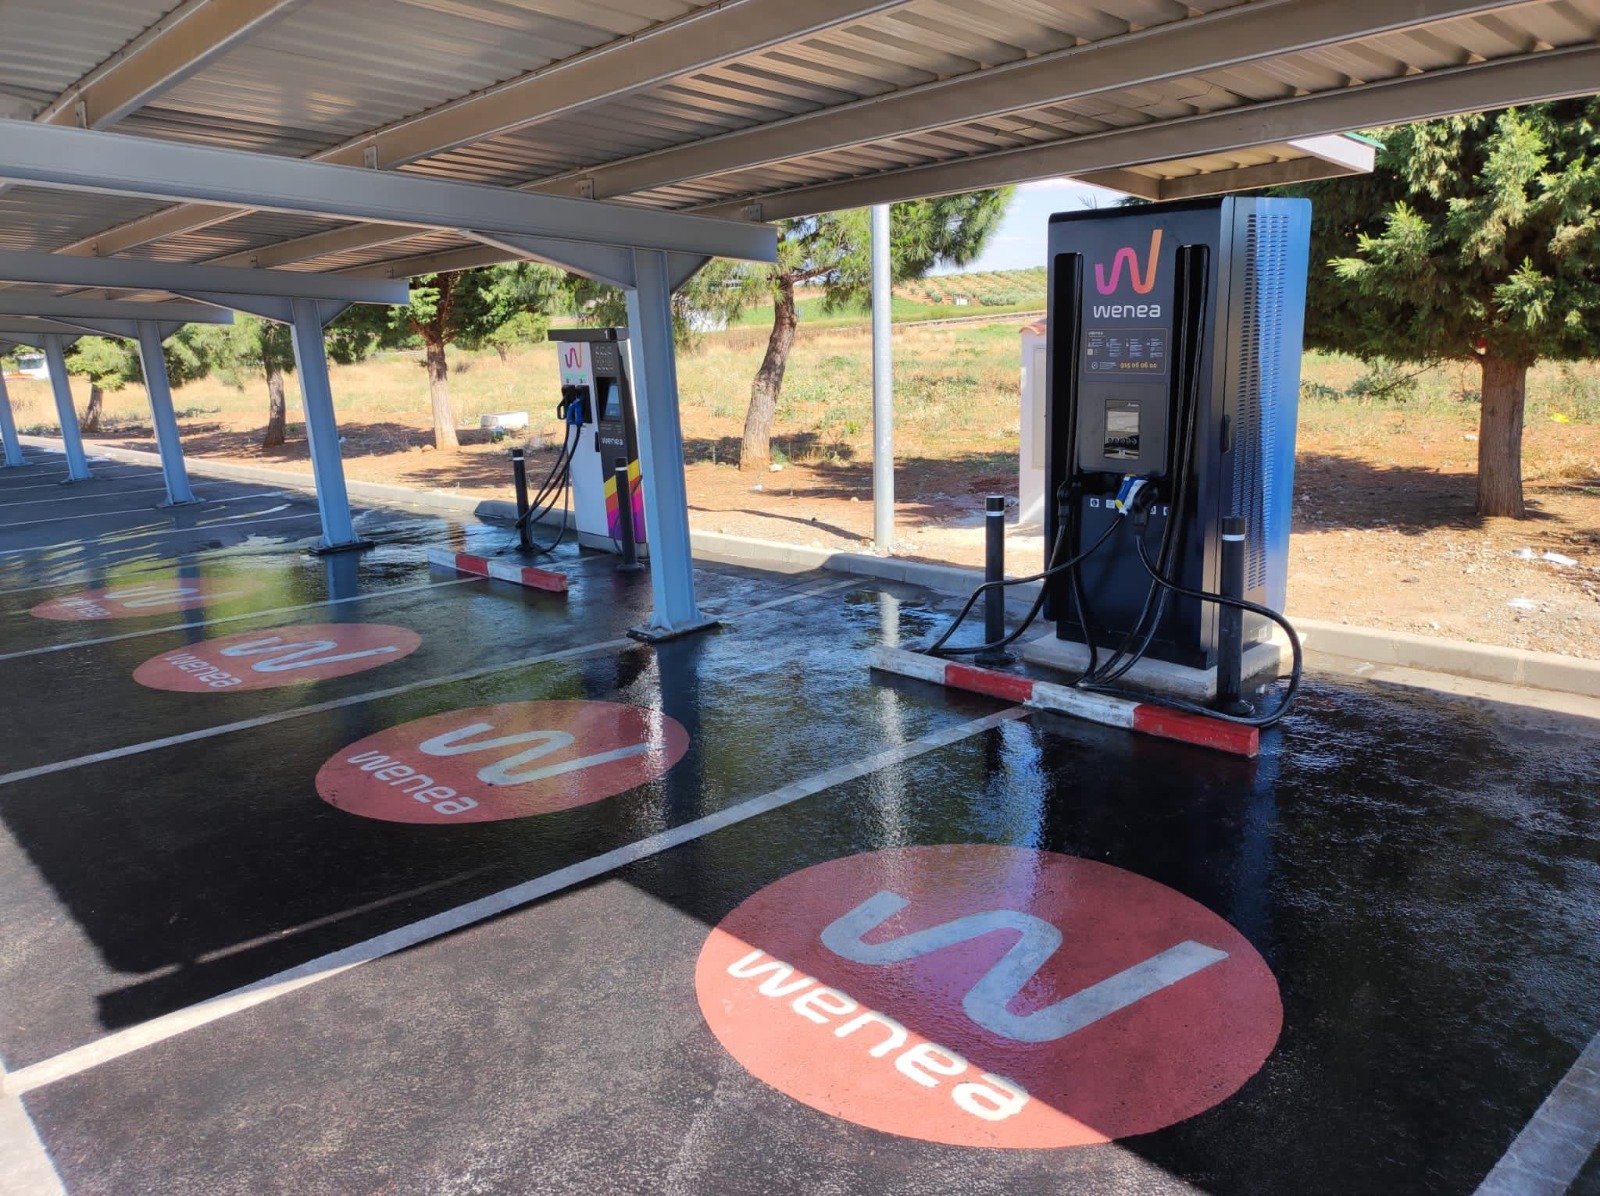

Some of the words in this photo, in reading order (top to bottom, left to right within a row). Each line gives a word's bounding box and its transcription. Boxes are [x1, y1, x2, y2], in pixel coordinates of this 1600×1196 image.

[1093, 304, 1161, 318] wenea
[601, 436, 624, 446] wenea
[164, 653, 242, 689] wenea
[346, 750, 479, 816] wenea
[726, 948, 1031, 1122] wenea
